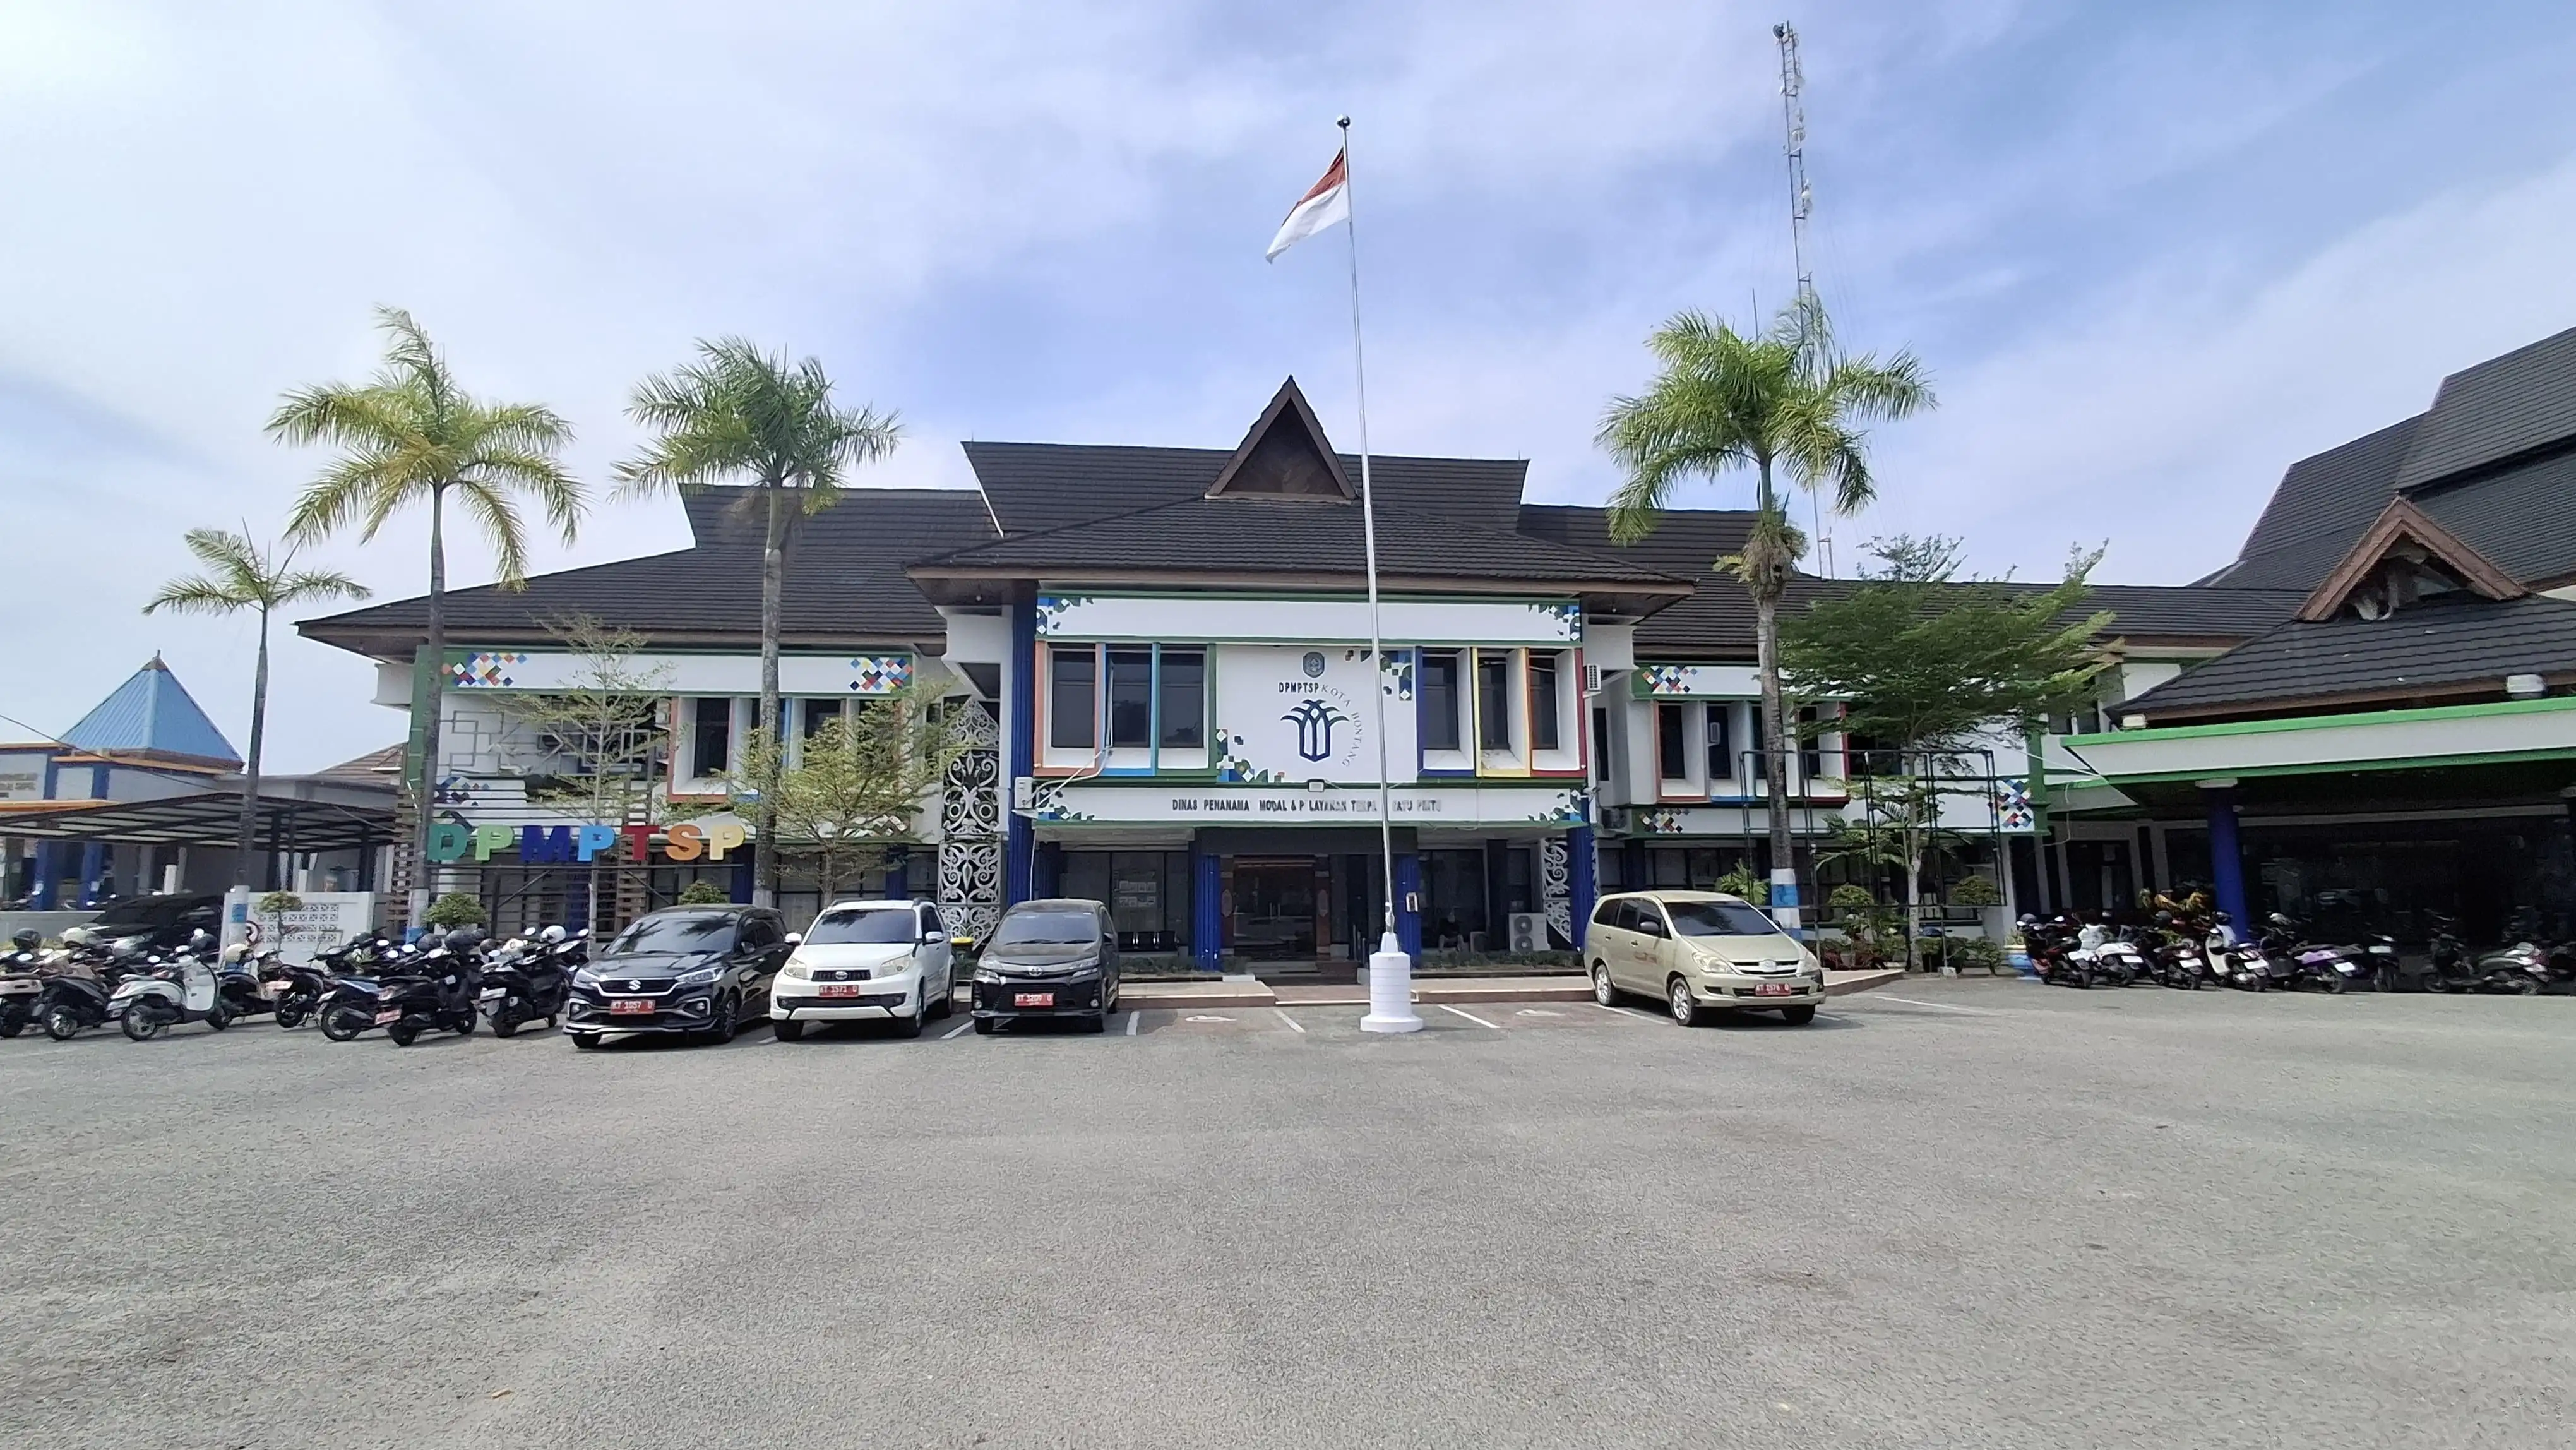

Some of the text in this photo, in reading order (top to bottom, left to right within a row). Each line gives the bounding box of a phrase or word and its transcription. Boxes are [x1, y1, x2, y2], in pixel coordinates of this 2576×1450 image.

[1279, 682, 1319, 693] DPMPTSP
[1321, 685, 1363, 767] KOTA BONTANG
[1172, 799, 1198, 811] DINAS
[1259, 799, 1287, 812] MODAL
[426, 824, 746, 861] DPMPTSP
